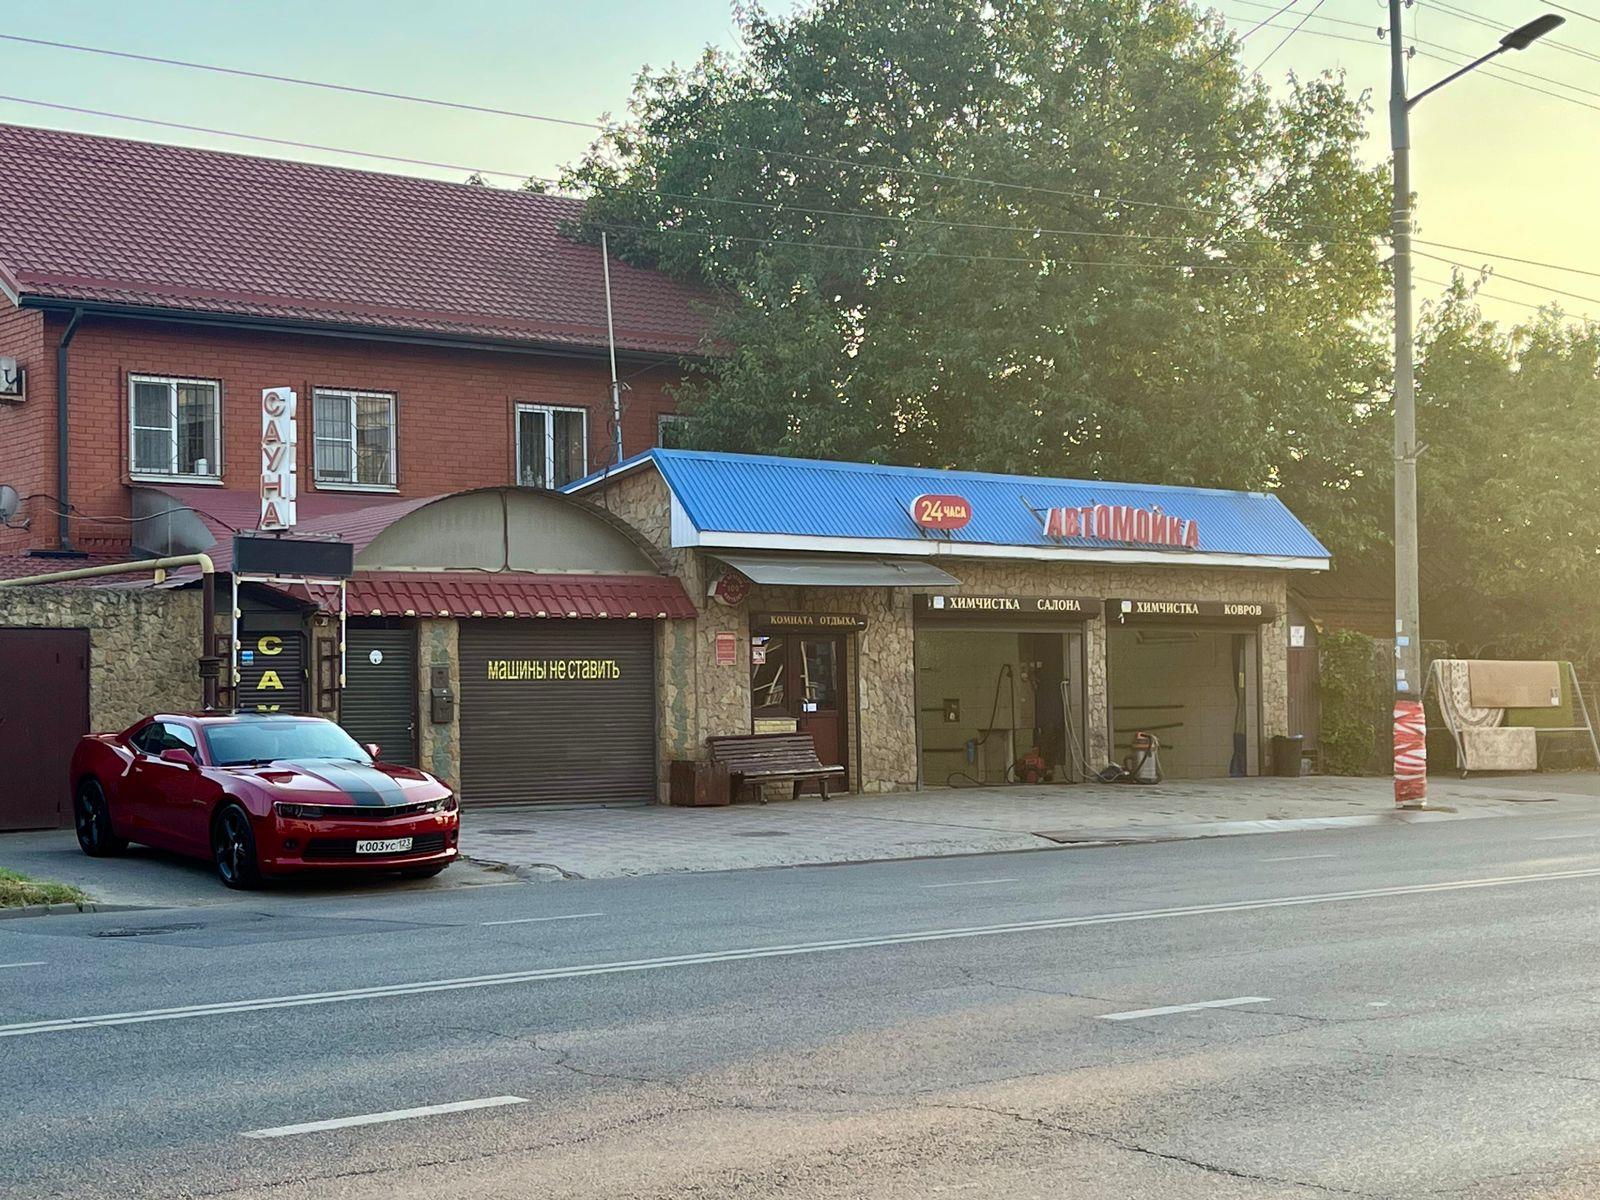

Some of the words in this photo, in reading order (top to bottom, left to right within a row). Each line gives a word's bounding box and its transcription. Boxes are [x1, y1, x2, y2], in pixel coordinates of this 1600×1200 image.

[261, 391, 287, 527] САУНА
[921, 500, 944, 522] 24
[943, 505, 967, 519] ЧАСА
[1043, 504, 1200, 547] АВТОМОЙКА
[949, 596, 1021, 610] ХИМЧИСТКА
[1036, 598, 1082, 611] САЛОНА
[1136, 601, 1200, 615] ХИМЧИСТКА
[1223, 603, 1263, 616] КОВРОВ
[770, 615, 814, 625] КОМНАТА
[819, 615, 857, 626] ОТДЫХА
[487, 659, 547, 680] машины
[549, 660, 567, 680] не
[567, 659, 621, 679] ставить
